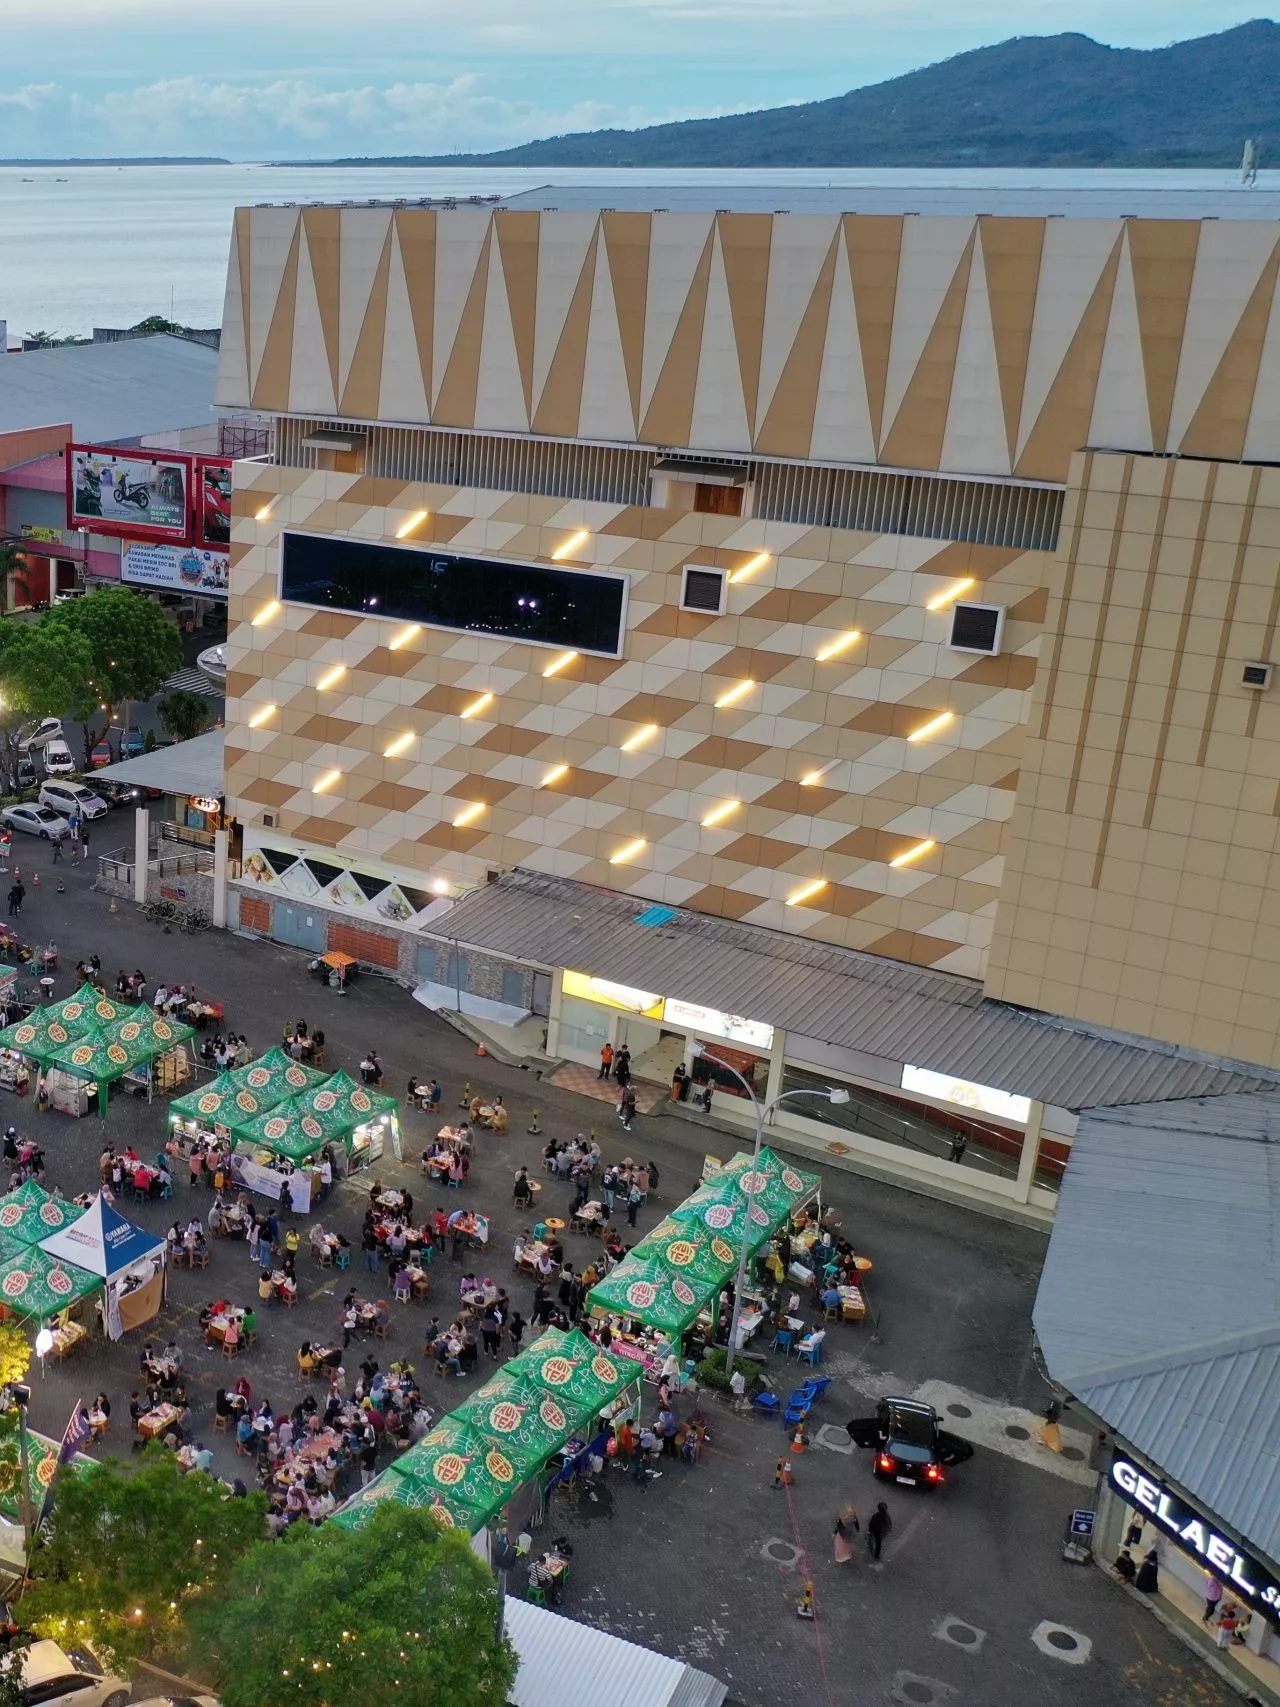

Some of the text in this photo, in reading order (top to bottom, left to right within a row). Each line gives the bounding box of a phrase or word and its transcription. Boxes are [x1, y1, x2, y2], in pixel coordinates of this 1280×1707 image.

[111, 1222, 132, 1238] YAMAHA
[669, 1250, 689, 1263] TEA
[671, 1243, 693, 1256] FRUIT
[629, 1291, 649, 1305] TEA
[631, 1284, 653, 1298] FRUIT
[548, 1359, 570, 1374] FRUIT
[546, 1367, 566, 1382] TEA
[496, 1406, 519, 1421] FRUIT
[494, 1414, 515, 1430] TEA
[439, 1458, 463, 1473] FRUIT
[437, 1465, 459, 1482] TEA
[1112, 1460, 1257, 1596] GELAEL
